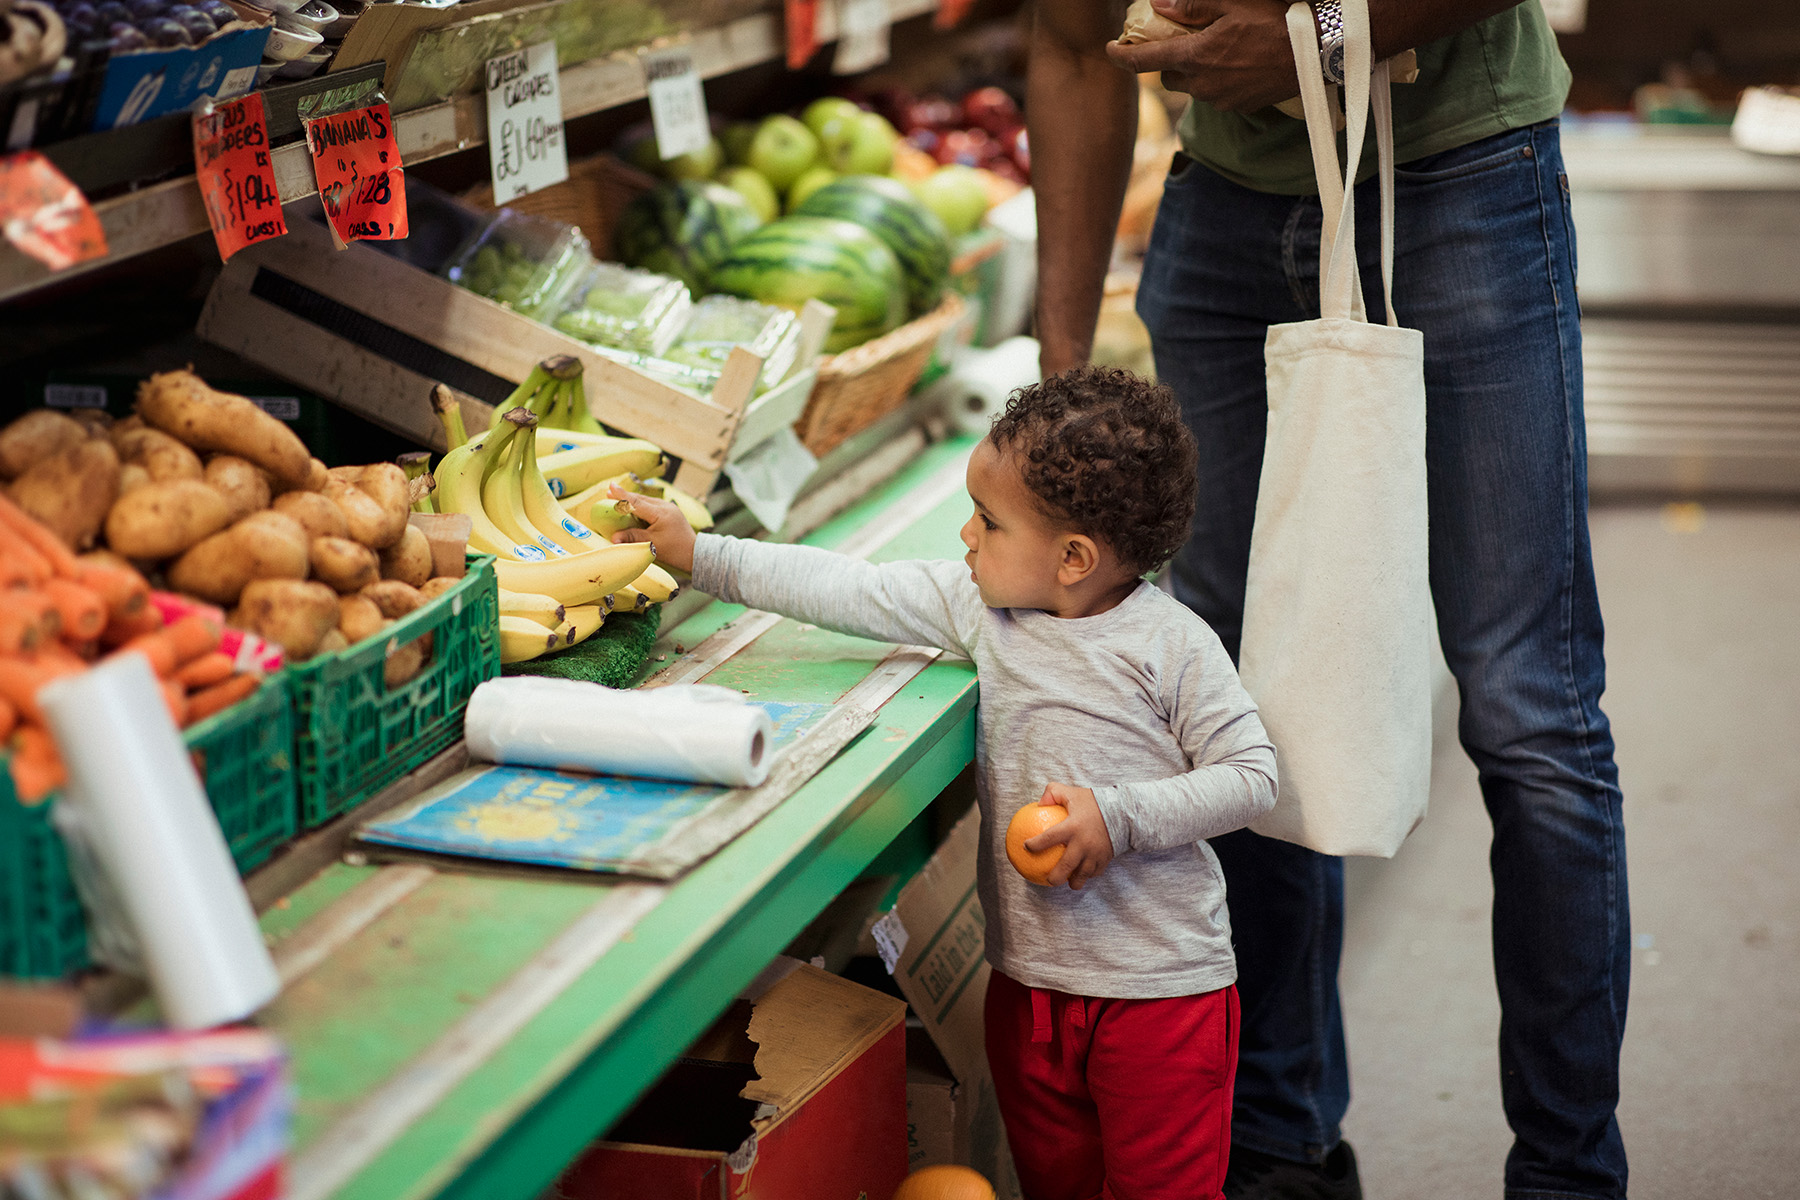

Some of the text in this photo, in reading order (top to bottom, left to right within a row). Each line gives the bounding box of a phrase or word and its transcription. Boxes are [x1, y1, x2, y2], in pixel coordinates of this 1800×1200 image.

[311, 109, 388, 158] BANANA'S
[236, 174, 276, 221] 1.94
[356, 171, 392, 205] 1.28
[919, 952, 955, 1004] Laid
